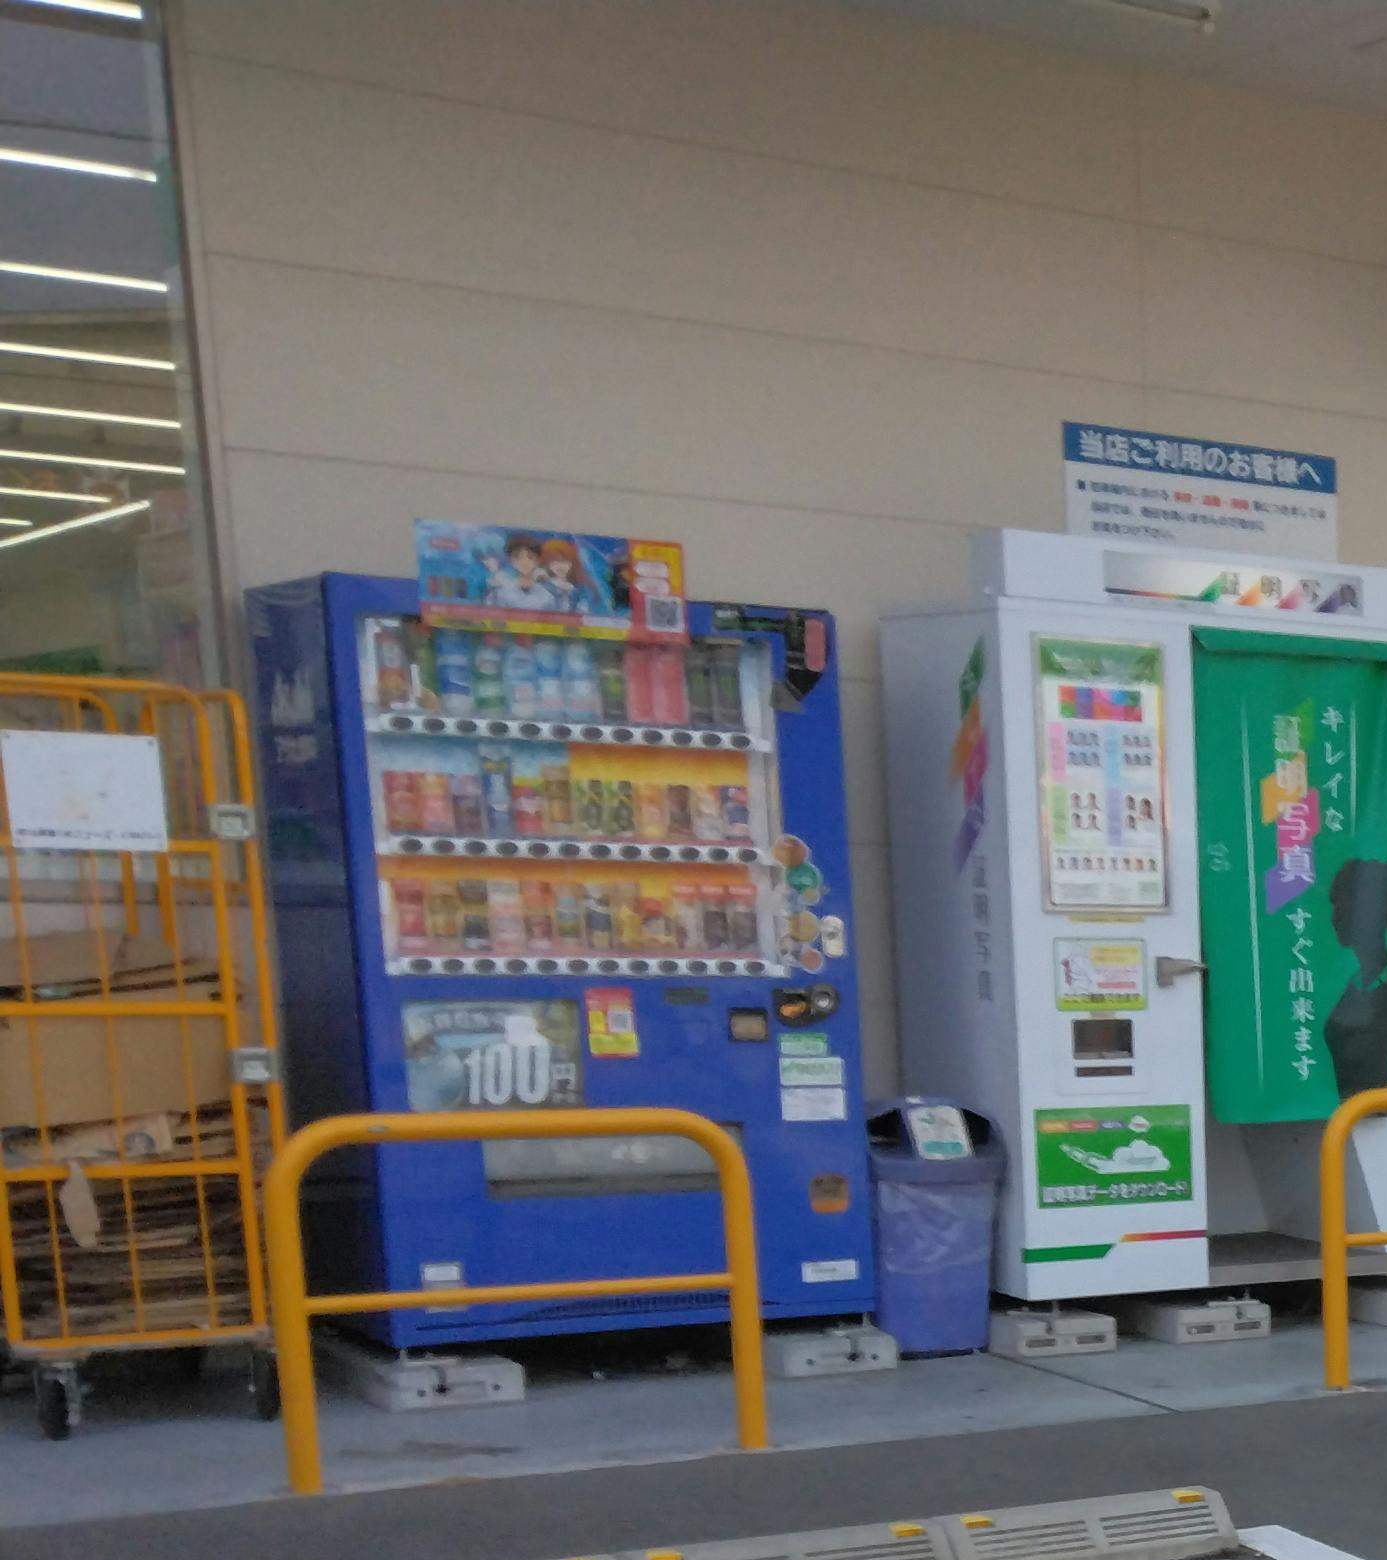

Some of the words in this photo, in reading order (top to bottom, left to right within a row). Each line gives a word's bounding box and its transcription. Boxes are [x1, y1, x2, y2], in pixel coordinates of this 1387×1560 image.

[1079, 429, 1322, 485] 当店ご利用のお客様へ
[1273, 715, 1315, 884] 証明写真
[1320, 706, 1345, 832] キレイな
[1286, 907, 1318, 1081] すぐ出来ます
